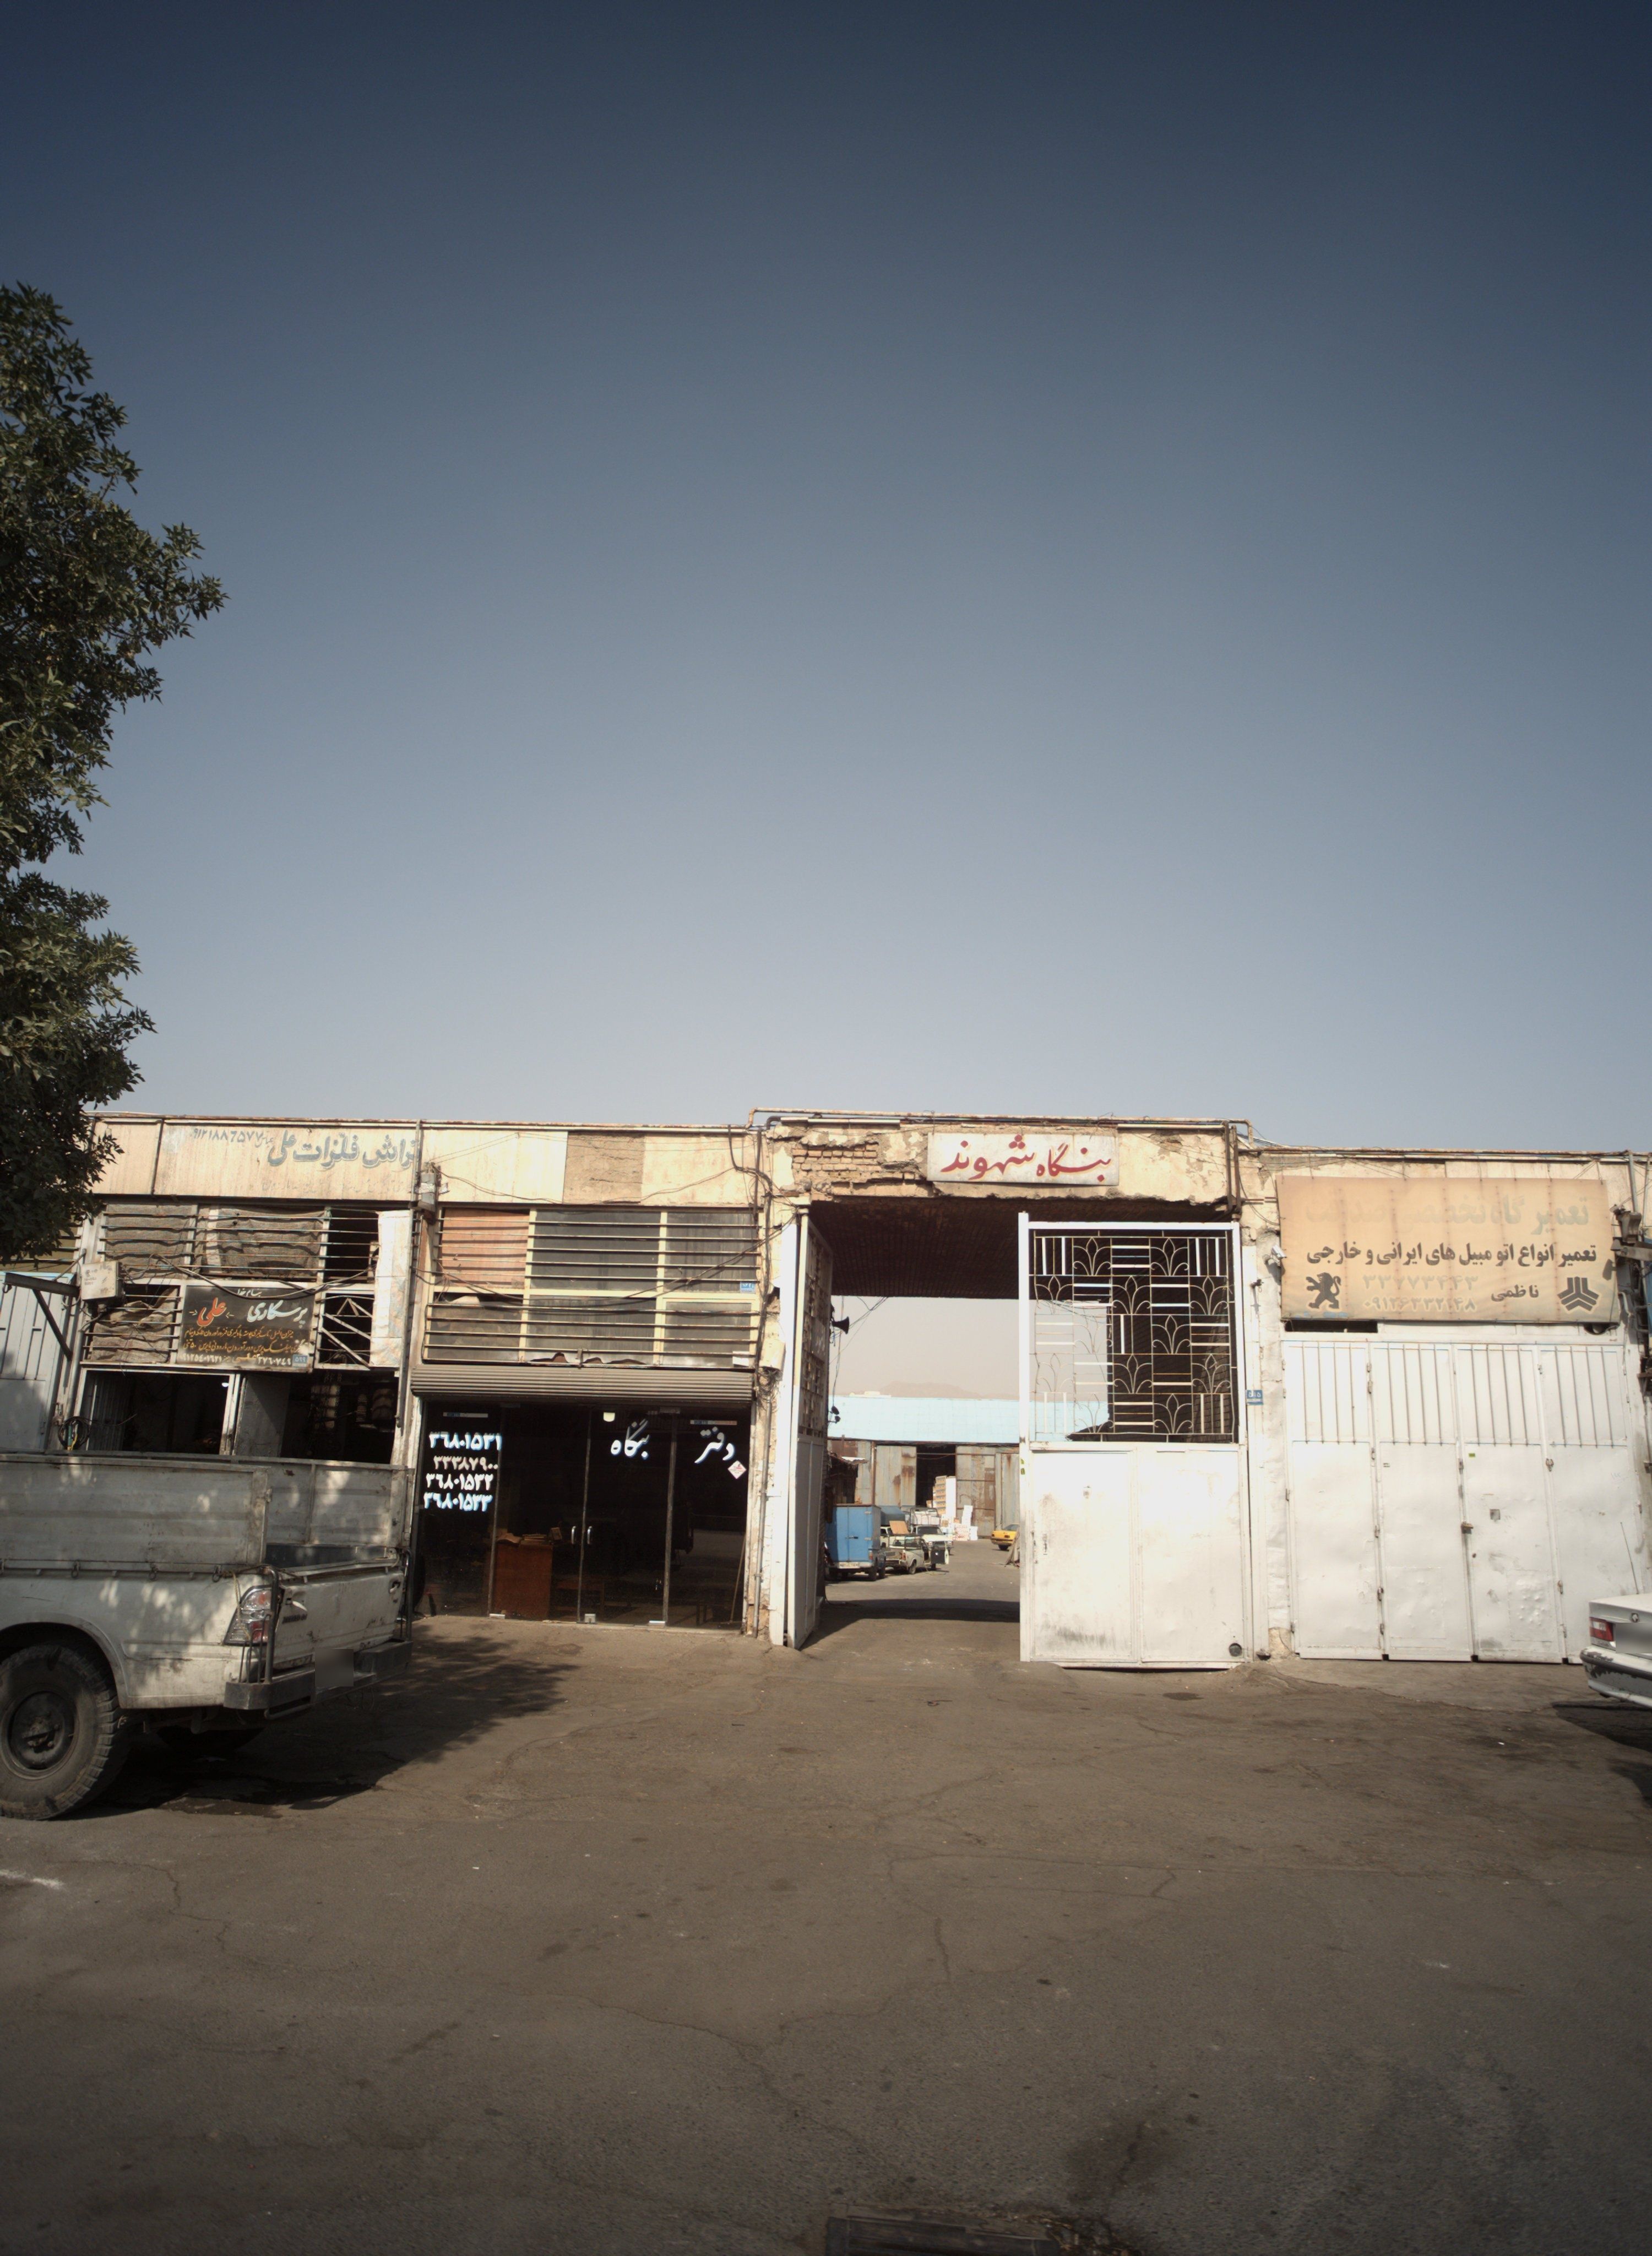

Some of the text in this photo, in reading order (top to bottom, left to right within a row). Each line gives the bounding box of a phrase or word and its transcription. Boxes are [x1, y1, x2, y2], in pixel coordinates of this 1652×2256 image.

[268, 1129, 297, 1167] علی
[292, 1131, 360, 1168] فلزات
[941, 1134, 1111, 1183] بنگاه شهوند
[1530, 1196, 1589, 1235] تعمیر
[1306, 1241, 1361, 1265] خارجی
[1365, 1249, 1373, 1265] و
[1377, 1243, 1422, 1266] ایرانی
[1425, 1244, 1456, 1266] های
[1518, 1244, 1555, 1267] انواع
[1558, 1245, 1597, 1267] تعمیر
[197, 1297, 308, 1328] پرسکاری علی
[428, 1431, 503, 1451] ۳۶۸۰۱۵۳۱
[611, 1418, 735, 1464] دفتر بنگاه
[433, 1455, 499, 1471] ۳۳۳۸۷۹۰۰
[426, 1473, 494, 1491] ۳۶۸۰۱۵۳۲
[423, 1492, 493, 1512] ۳۶۸۰۱۵۳۳
